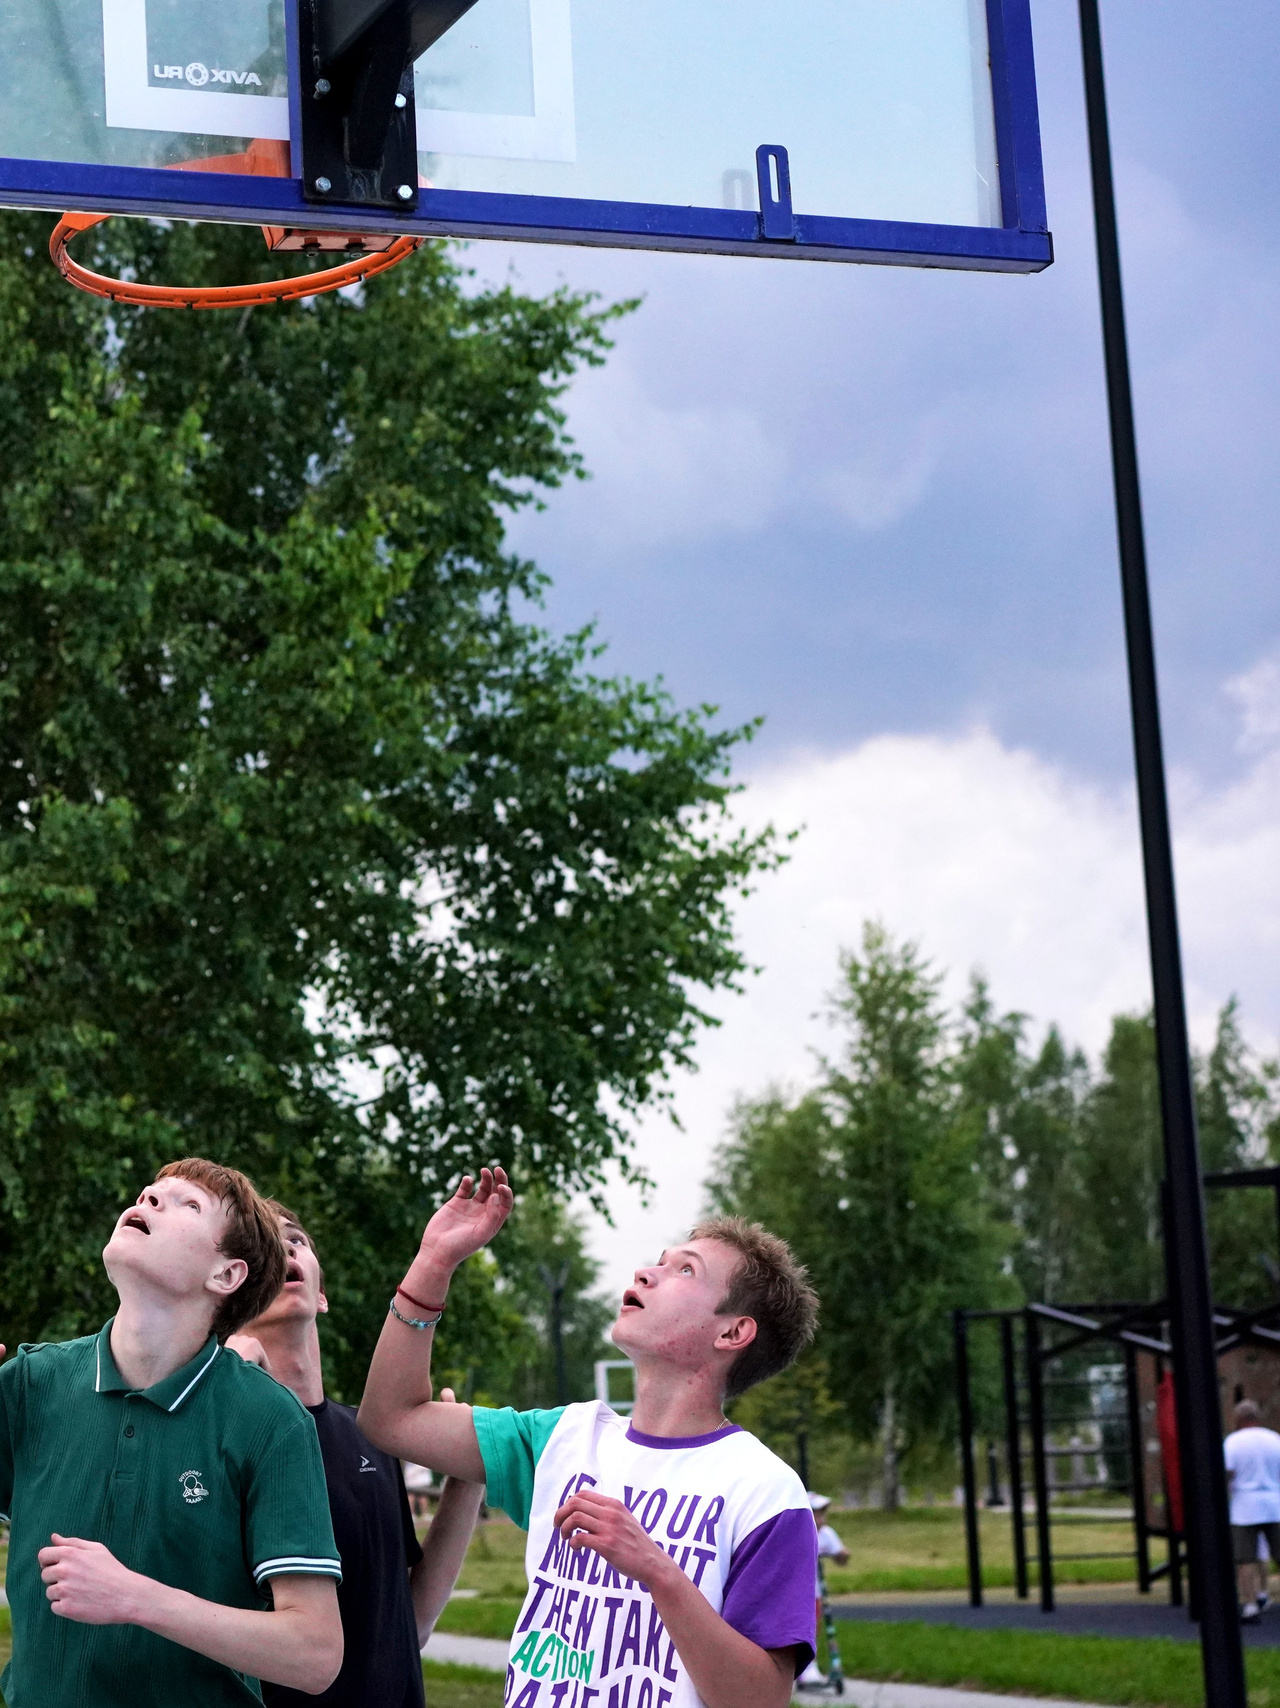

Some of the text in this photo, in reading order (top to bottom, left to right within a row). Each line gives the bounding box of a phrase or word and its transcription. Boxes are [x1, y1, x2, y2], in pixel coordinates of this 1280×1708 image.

[624, 1485, 725, 1547] YOUR
[517, 1575, 599, 1651] THEN
[511, 1630, 595, 1686] ACTION
